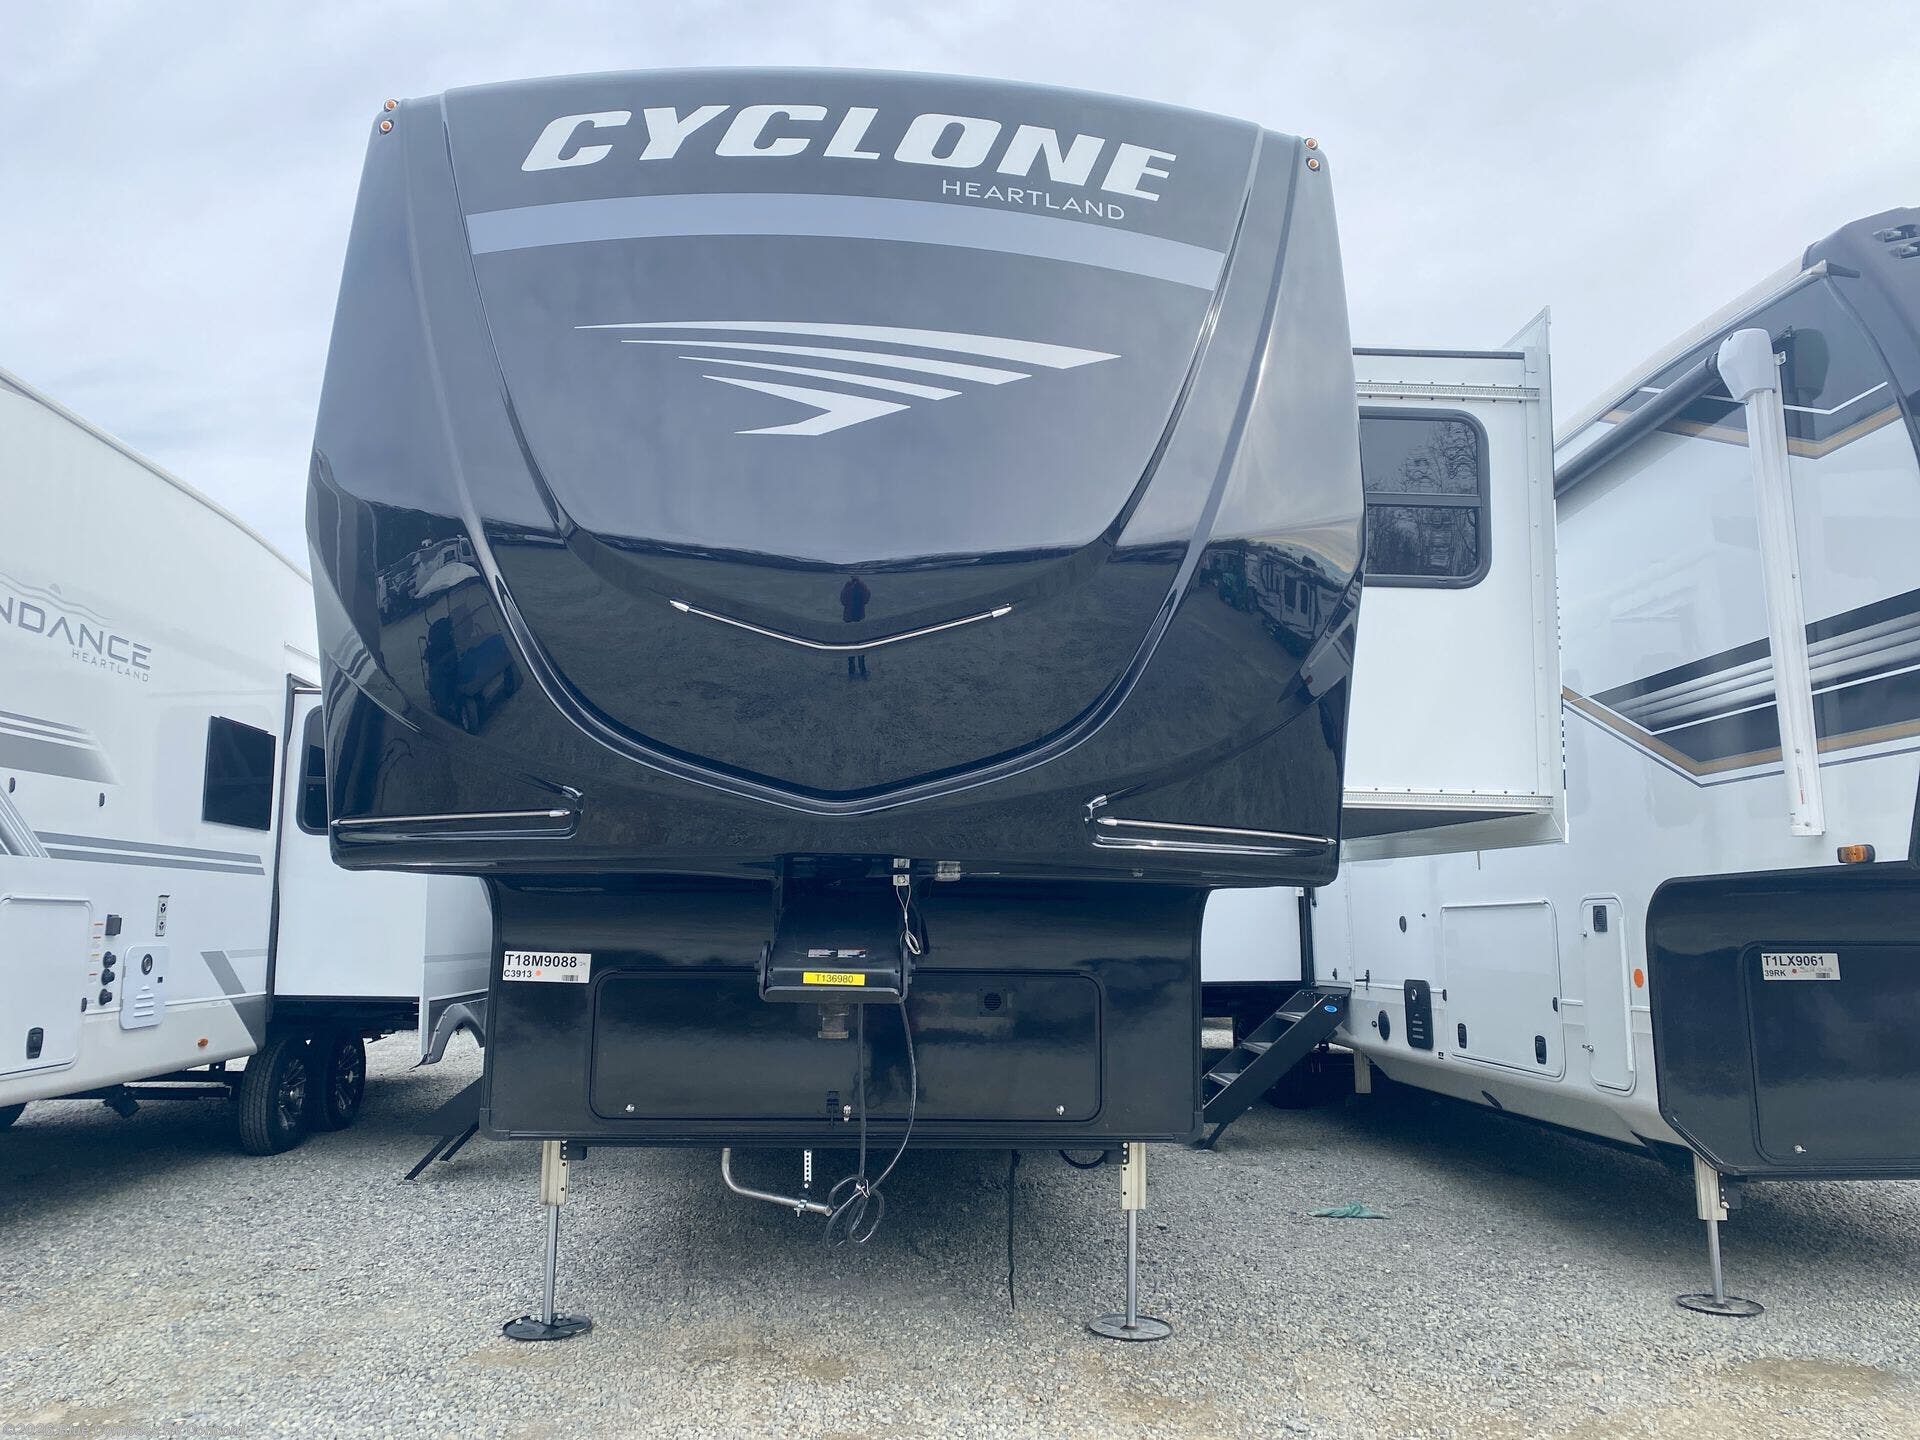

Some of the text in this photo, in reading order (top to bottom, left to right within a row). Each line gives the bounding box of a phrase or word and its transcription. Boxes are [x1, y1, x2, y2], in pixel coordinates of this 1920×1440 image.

[521, 104, 1177, 201] CYCLONE
[942, 179, 1125, 220] HEARTLAND
[71, 648, 149, 682] HEARTLAND
[505, 954, 577, 968] T18M9088
[1763, 955, 1824, 967] T1LX9061
[503, 969, 532, 978] C3913
[815, 974, 854, 984] T136980
[1764, 969, 1787, 977] 39RK
